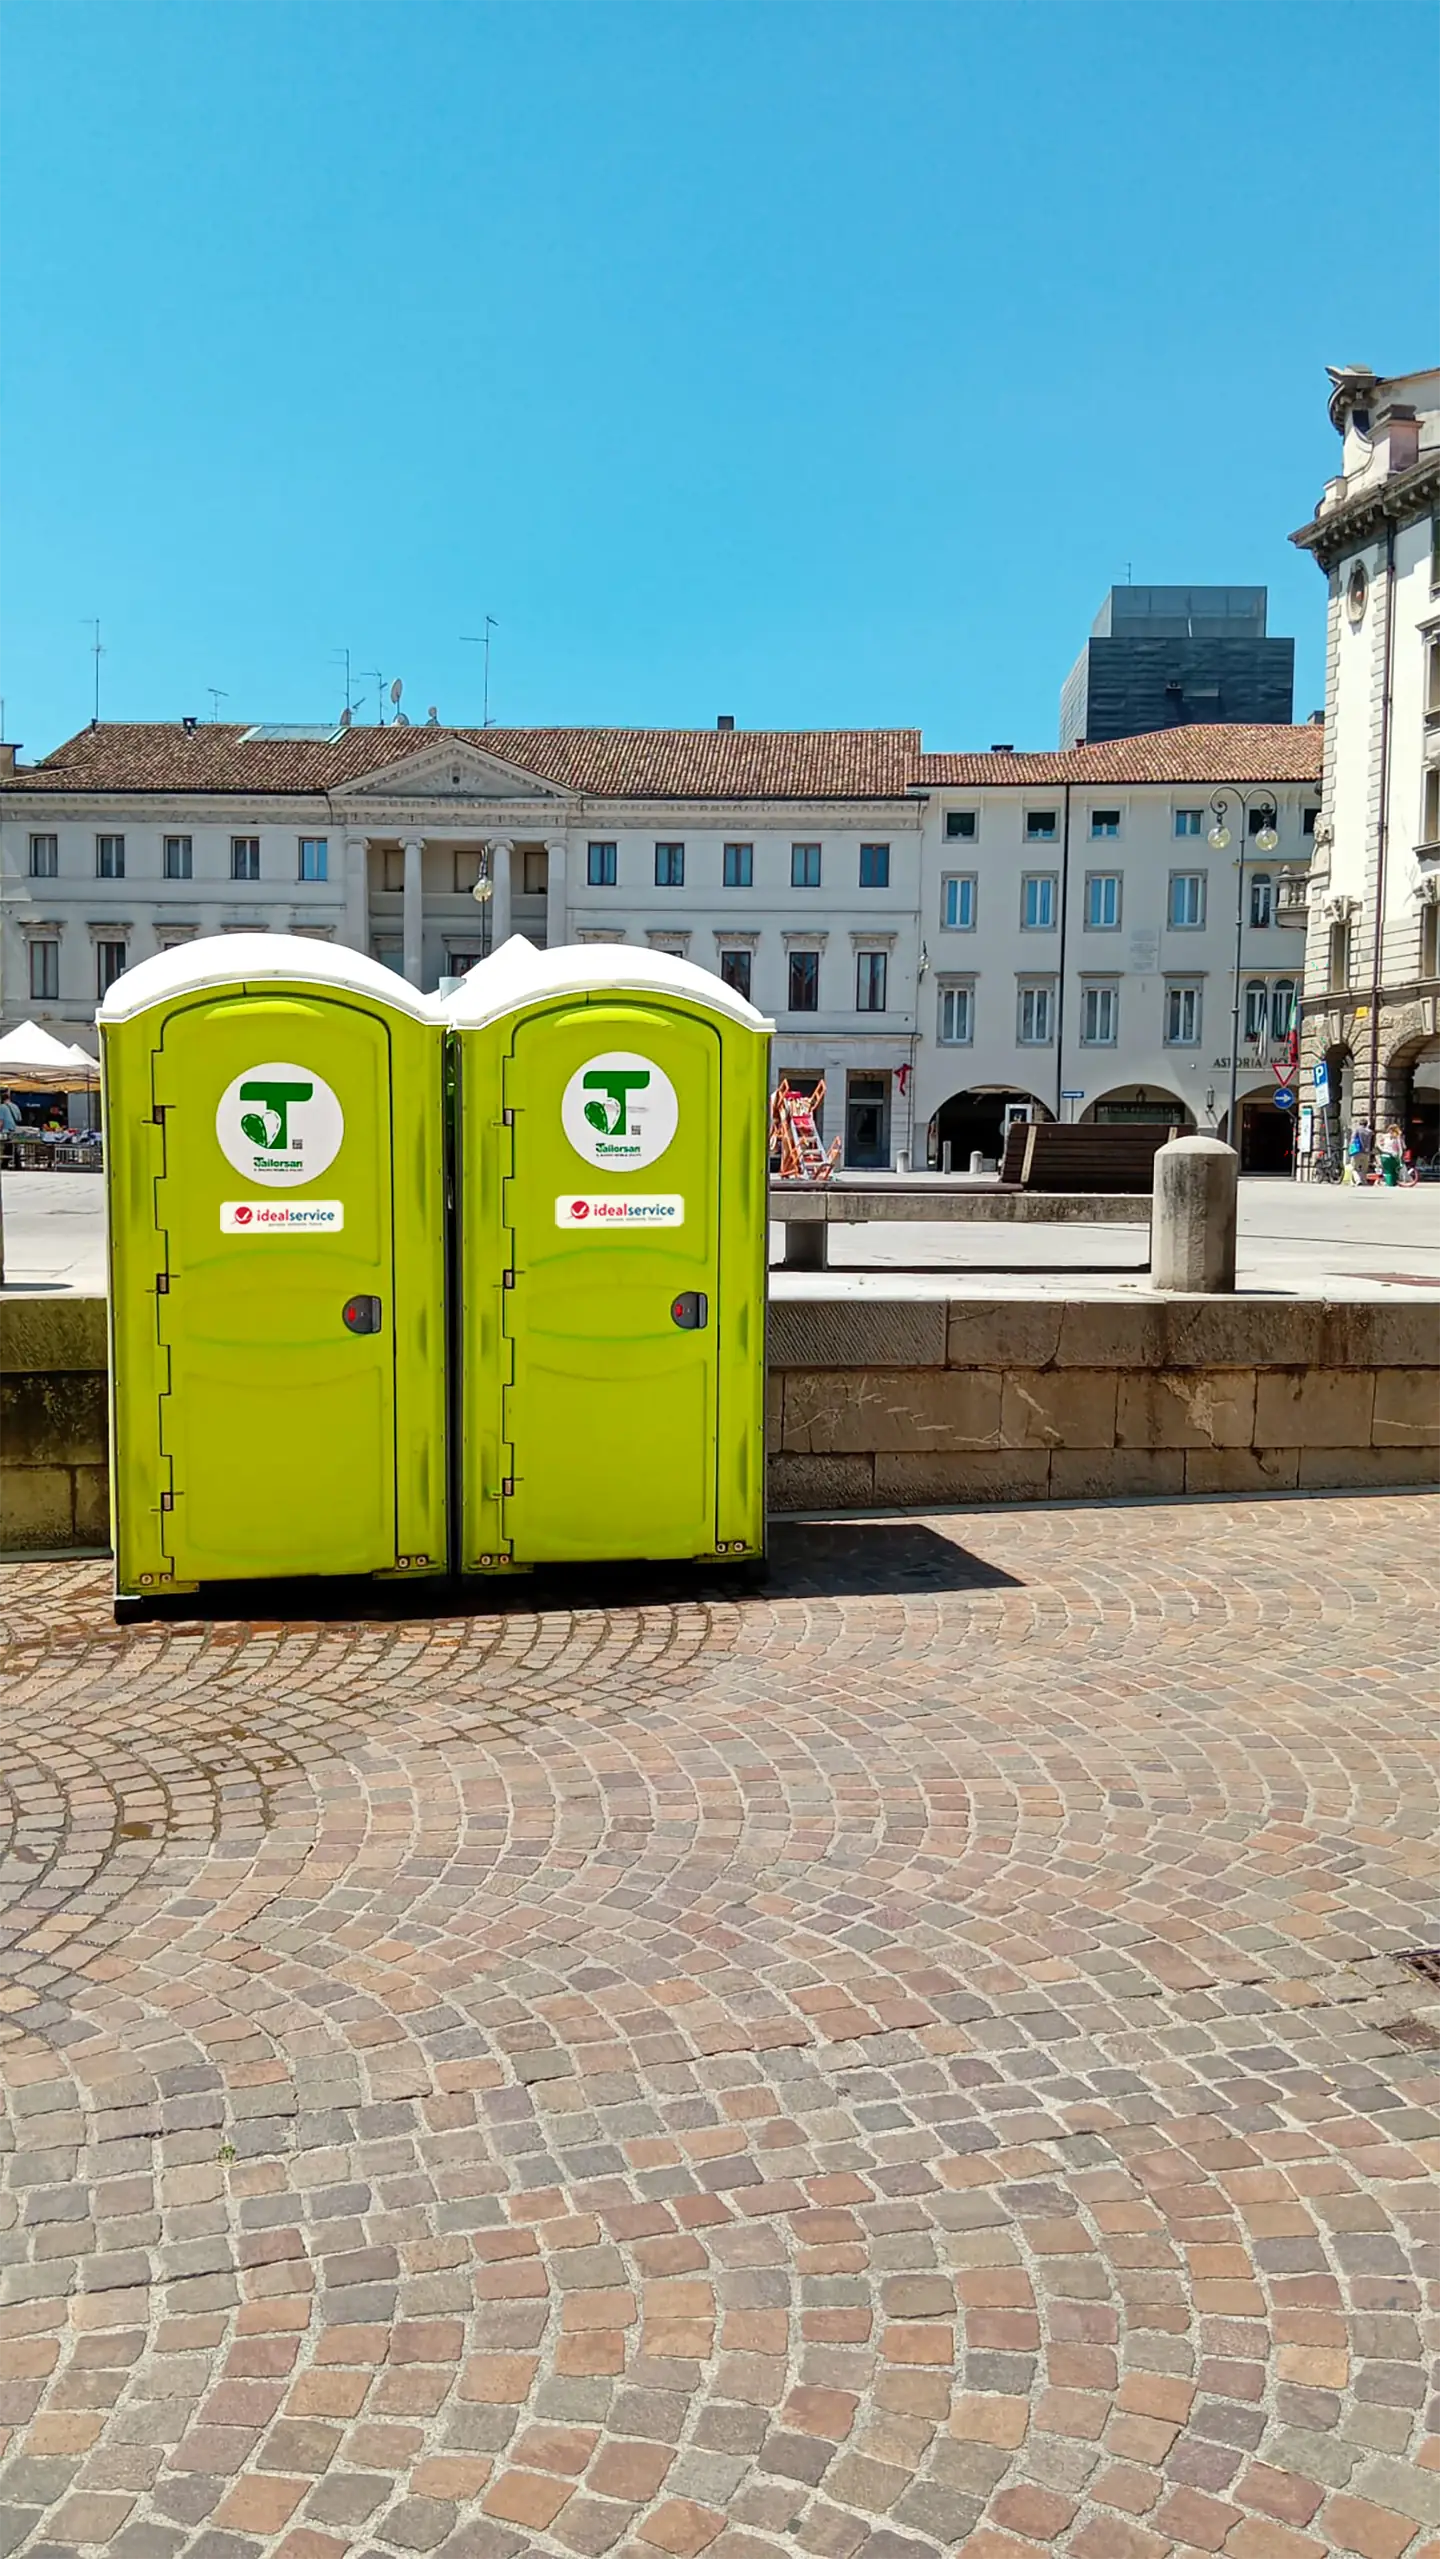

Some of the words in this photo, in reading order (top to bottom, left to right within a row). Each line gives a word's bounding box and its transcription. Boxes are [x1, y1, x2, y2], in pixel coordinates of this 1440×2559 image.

[1213, 1057, 1262, 1069] ASTORIA
[1315, 1066, 1324, 1083] P
[595, 1143, 641, 1153] Tailorsan
[253, 1157, 303, 1167] Tailorsan
[257, 1209, 335, 1222] idealservice
[594, 1203, 675, 1216] idealservice
